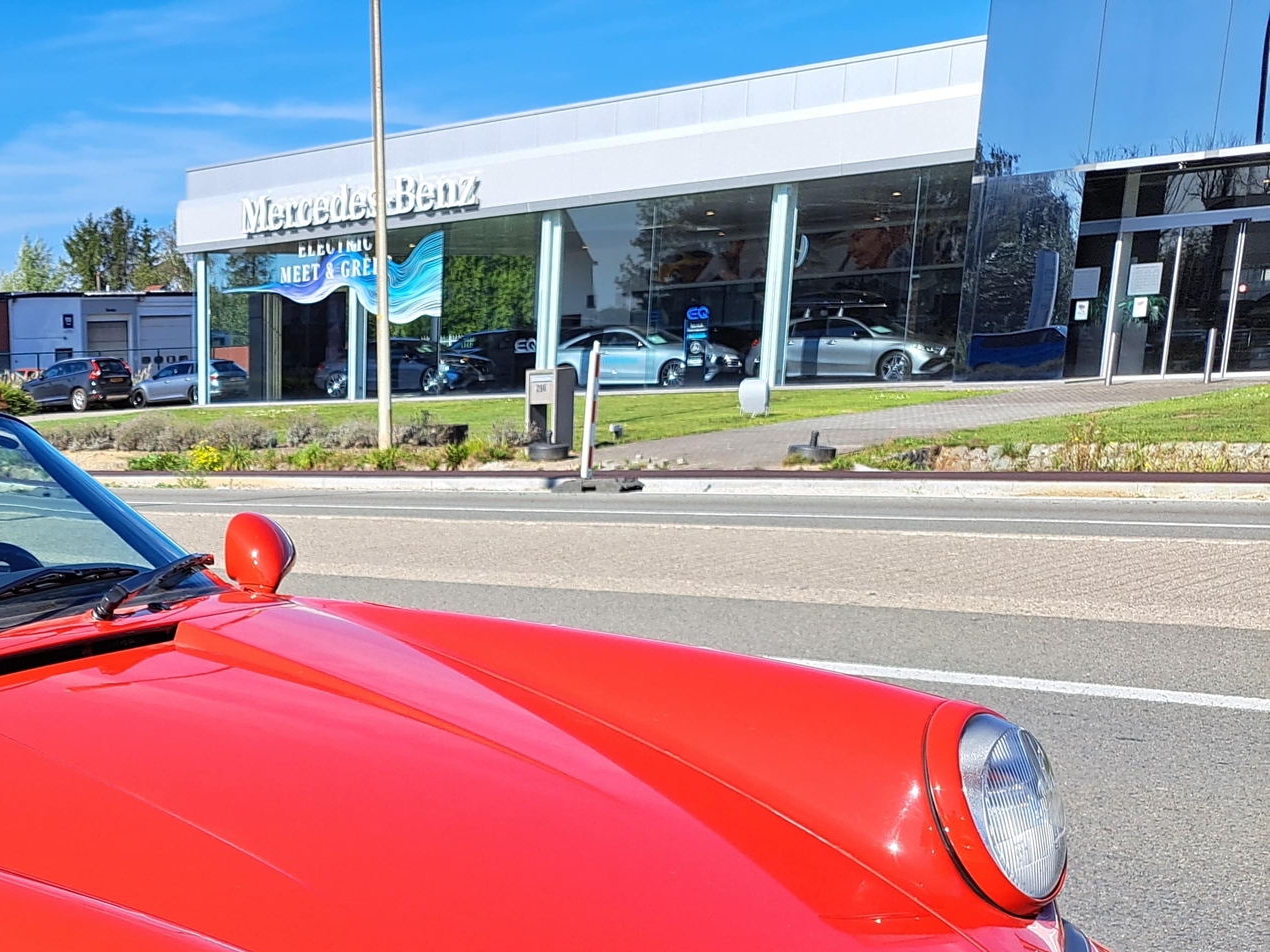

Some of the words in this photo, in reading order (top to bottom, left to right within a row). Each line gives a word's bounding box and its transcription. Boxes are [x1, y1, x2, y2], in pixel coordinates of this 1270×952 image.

[280, 264, 320, 284] MEET
[325, 262, 334, 279] &
[687, 306, 710, 320] EQ
